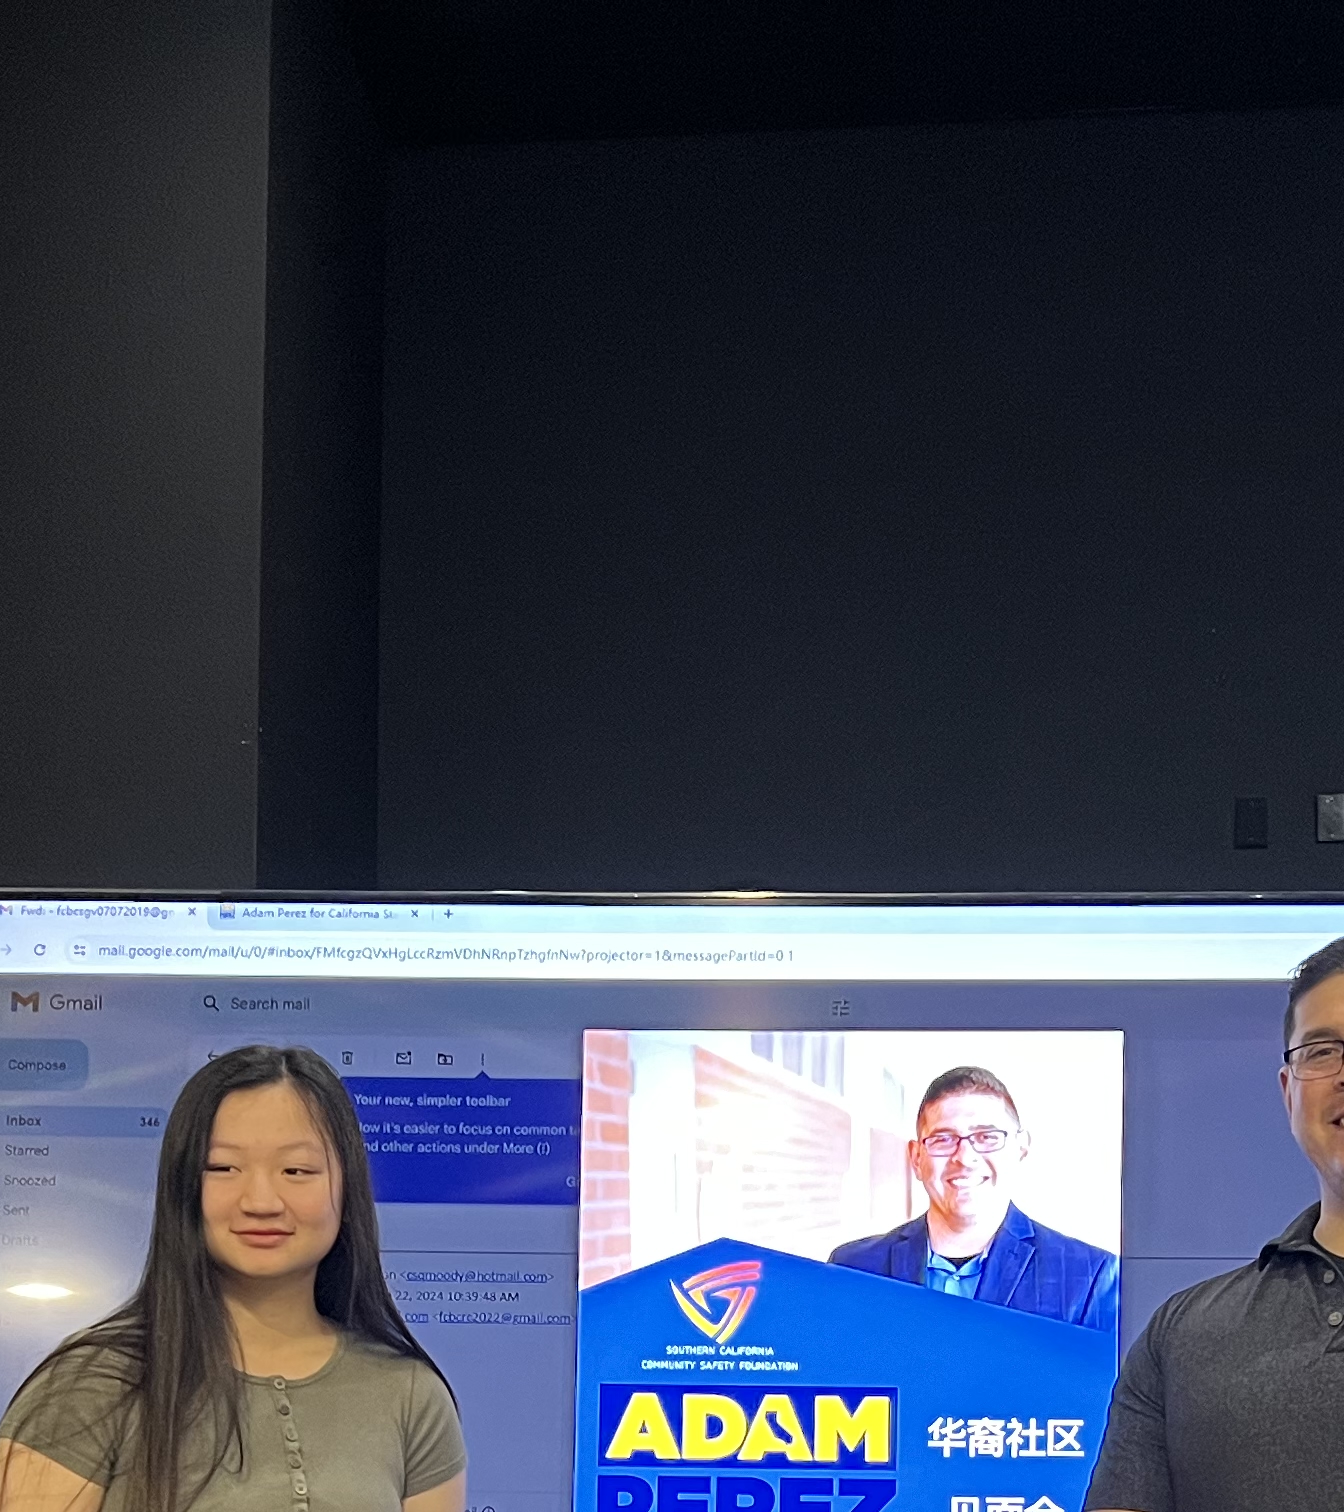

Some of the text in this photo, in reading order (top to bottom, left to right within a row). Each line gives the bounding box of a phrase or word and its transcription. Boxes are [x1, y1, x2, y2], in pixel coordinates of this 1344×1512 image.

[242, 907, 275, 919] Adam
[277, 907, 307, 919] Perez
[309, 907, 325, 919] for
[328, 907, 380, 920] California
[49, 994, 103, 1011] Gmail
[230, 996, 311, 1011] Search mail
[8, 1058, 67, 1073] Compose
[354, 1093, 512, 1109] Your new, simpler toolbar
[6, 1114, 42, 1127] Inbox
[403, 1121, 439, 1135] easier
[443, 1123, 457, 1135] to
[458, 1122, 493, 1136] focus
[494, 1125, 511, 1136] on
[513, 1125, 567, 1137] common
[4, 1144, 50, 1157] Starred
[363, 1139, 379, 1153] nd
[381, 1140, 414, 1153] other
[417, 1140, 461, 1154] actions
[464, 1141, 500, 1154] under
[502, 1142, 534, 1155] More
[3, 1174, 57, 1187] Snoozed
[2, 1204, 30, 1216] Sent
[415, 1290, 444, 1302] 2024
[499, 1291, 520, 1303] AM
[665, 1344, 775, 1357] SOUTHERN CALIFORNIA
[640, 1359, 799, 1372] COMMUNITY SAFETY FOUNDATION
[604, 1391, 891, 1464] ADAM
[926, 1416, 1086, 1460] 华裔社区
